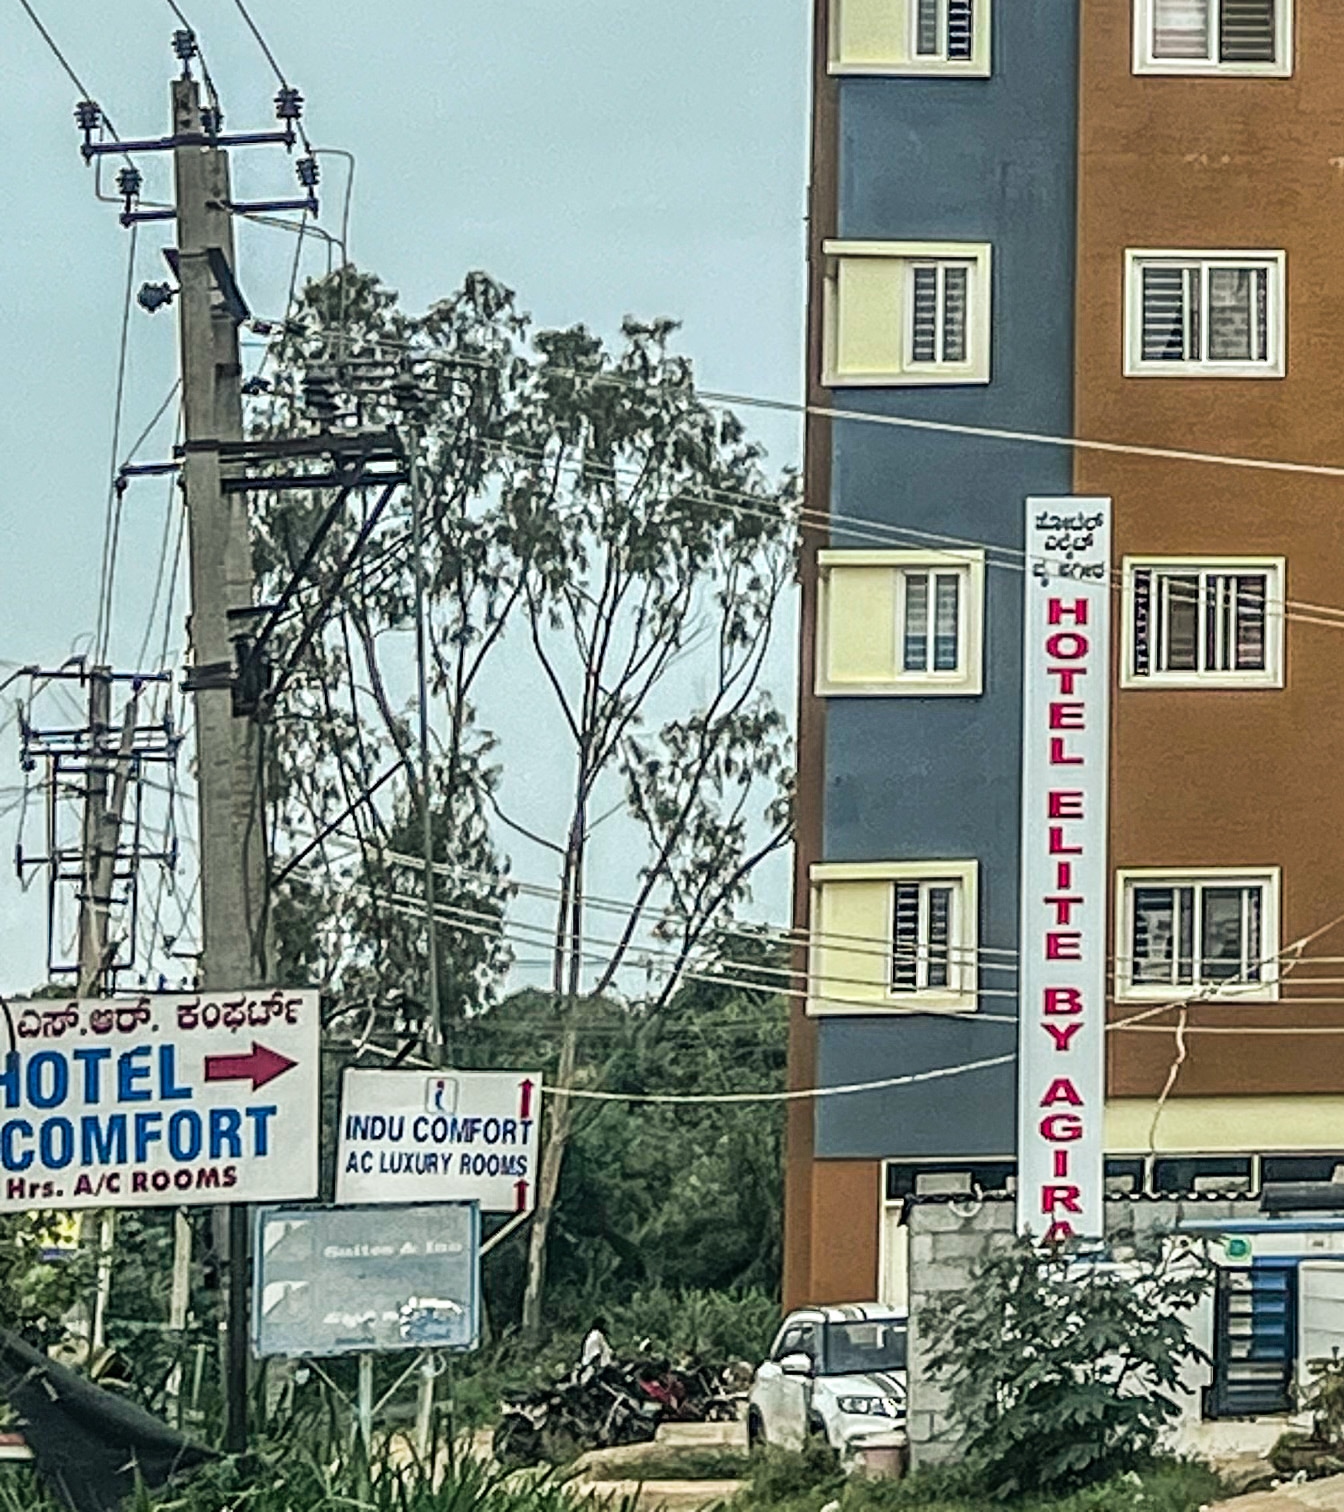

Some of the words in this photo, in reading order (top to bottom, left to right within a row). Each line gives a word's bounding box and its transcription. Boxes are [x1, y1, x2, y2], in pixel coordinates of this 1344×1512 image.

[1045, 597, 1089, 766] HOTEL
[1043, 791, 1085, 960] ELITE
[1040, 987, 1085, 1051] BY
[0, 1105, 278, 1172] COMFORT
[346, 1114, 405, 1142] INDU
[413, 1116, 534, 1145] COMFORT
[5, 1178, 64, 1200] Hrs.
[73, 1172, 121, 1197] A/C
[131, 1166, 238, 1193] ROOMS
[345, 1150, 374, 1174] AC
[379, 1151, 453, 1175] LUXURY
[459, 1153, 528, 1177] ROOMS
